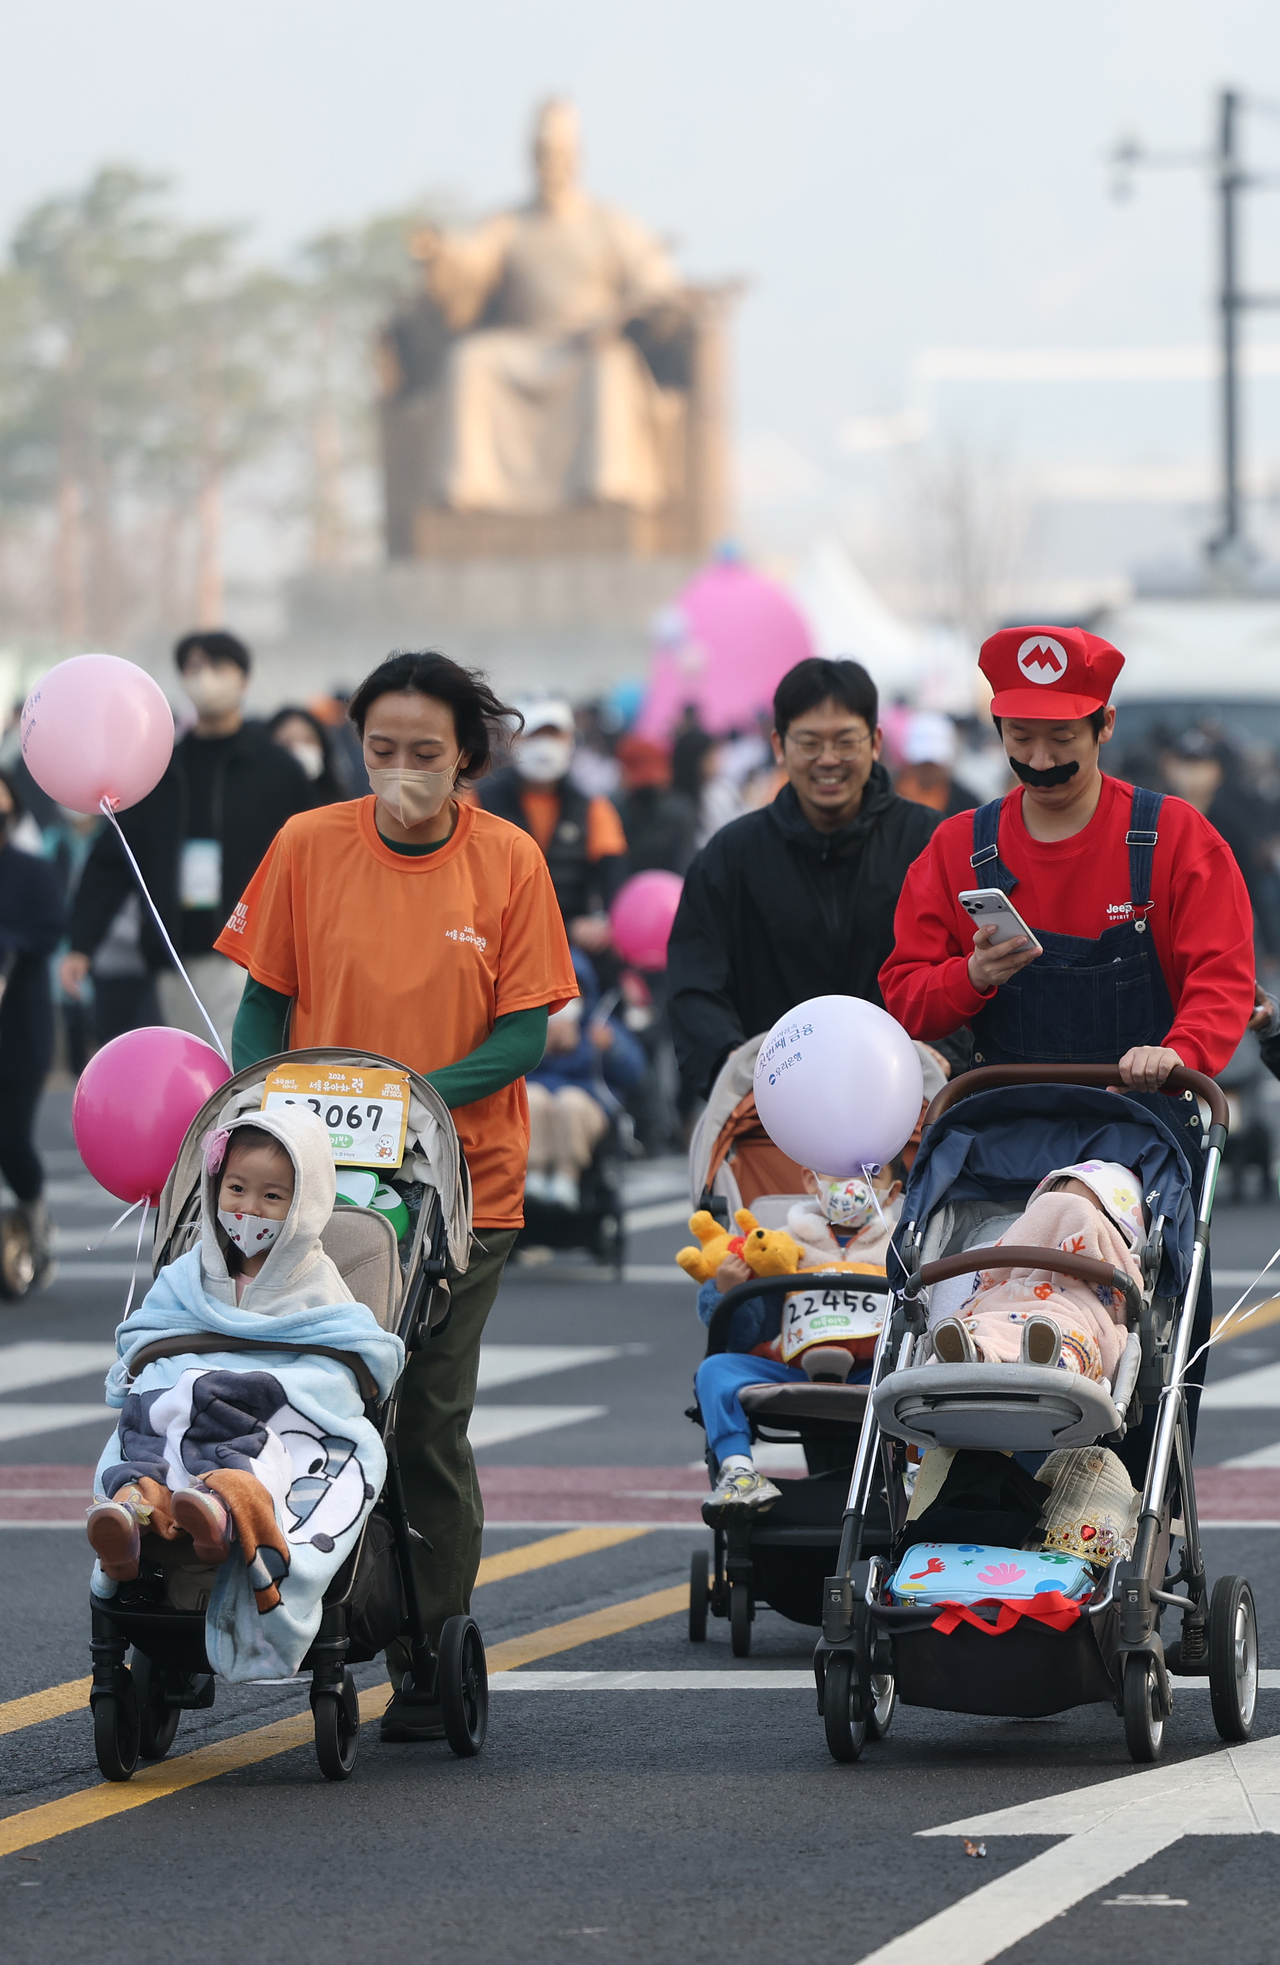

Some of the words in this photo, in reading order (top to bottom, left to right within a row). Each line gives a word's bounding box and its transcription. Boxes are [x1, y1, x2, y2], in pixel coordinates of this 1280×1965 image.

[1021, 643, 1063, 673] M
[1106, 903, 1133, 914] Jeep
[328, 1072, 346, 1081] 2026
[775, 1051, 803, 1077] 우리은행
[309, 1080, 323, 1092] 서울
[285, 1098, 384, 1132] 3067
[788, 1289, 877, 1324] 22456
